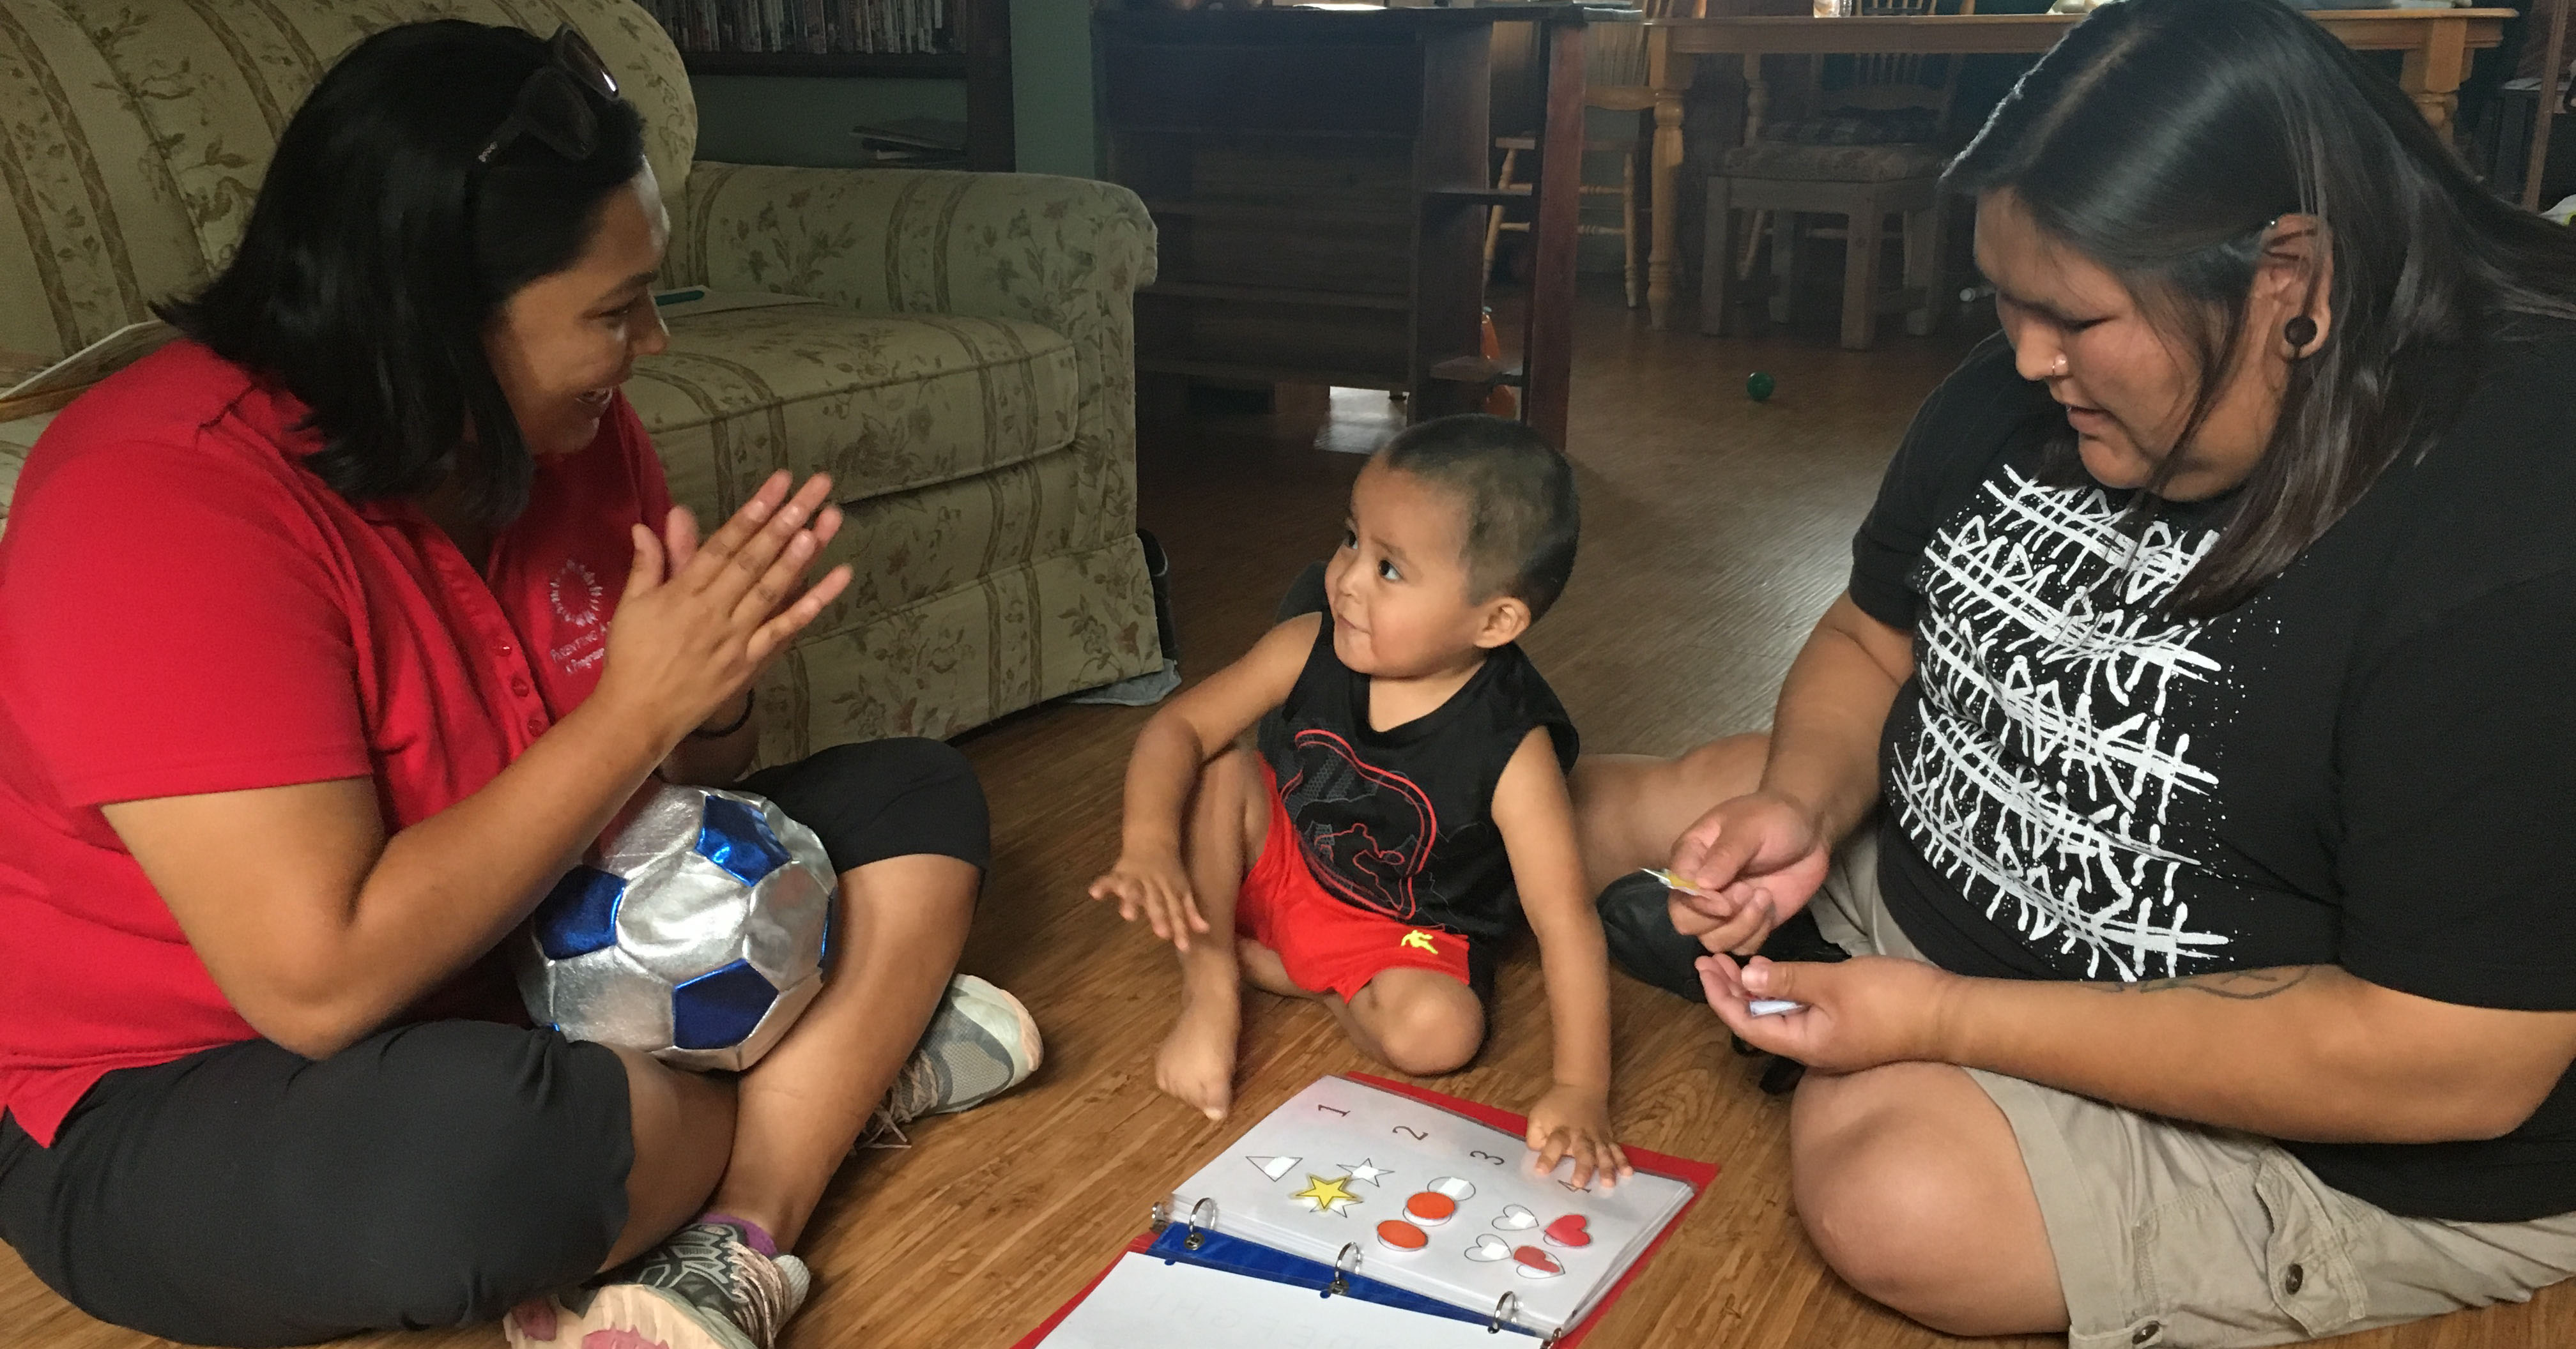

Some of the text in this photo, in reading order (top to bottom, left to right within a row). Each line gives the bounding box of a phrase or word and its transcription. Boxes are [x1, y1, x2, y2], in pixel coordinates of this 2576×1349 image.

[1317, 1104, 1351, 1117] 1
[1392, 1125, 1429, 1141] 2
[1469, 1150, 1505, 1166] 3
[1557, 1179, 1592, 1194] 4
